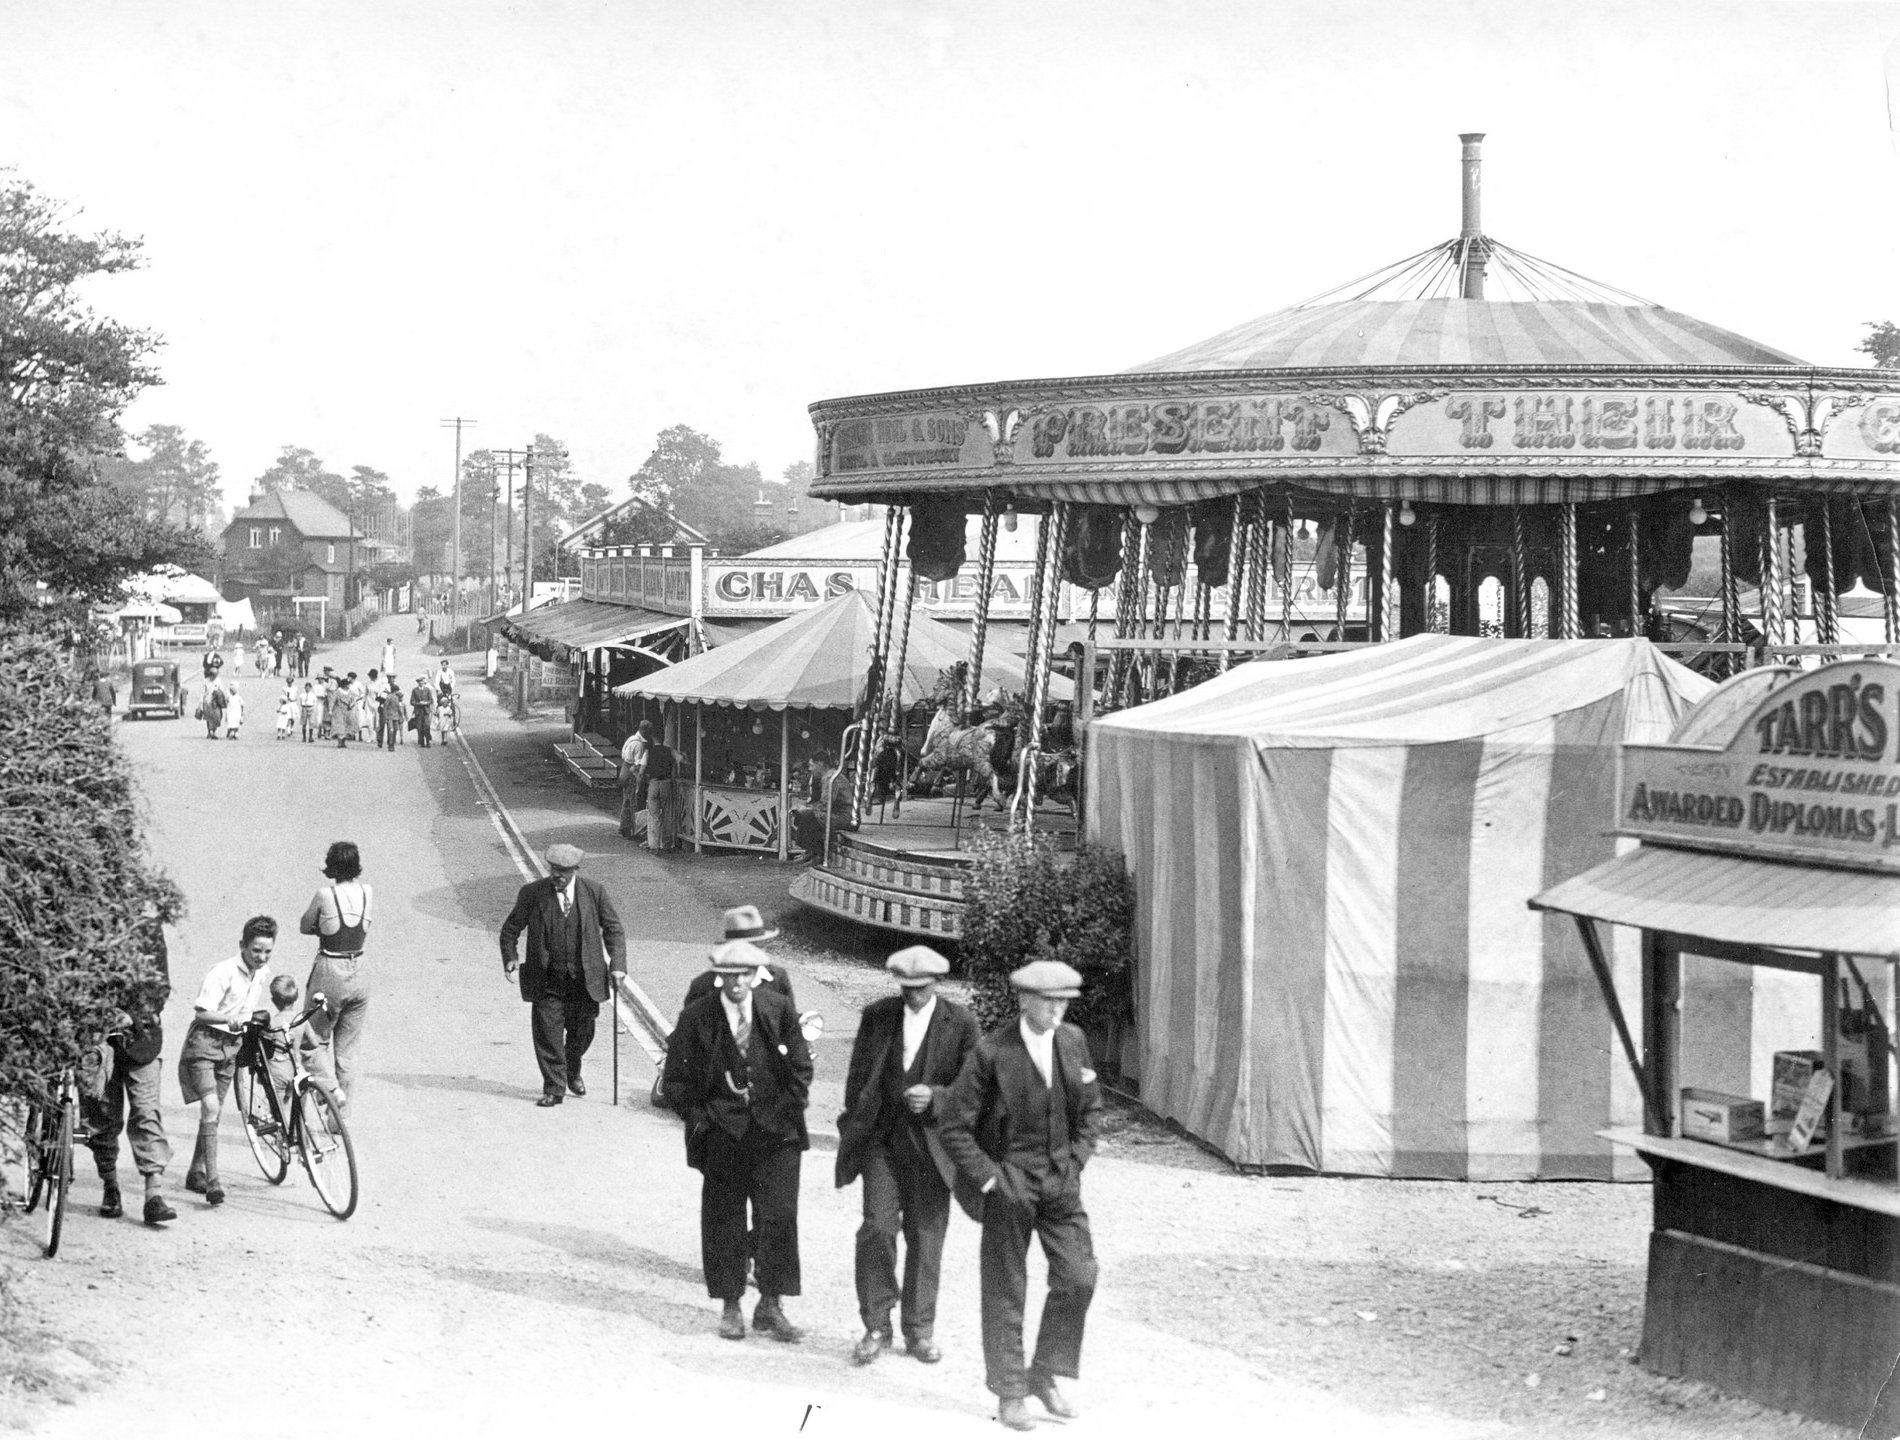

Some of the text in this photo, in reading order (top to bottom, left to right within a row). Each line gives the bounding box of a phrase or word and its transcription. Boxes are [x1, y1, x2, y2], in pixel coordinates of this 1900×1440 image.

[1032, 400, 1331, 458] PRESENT
[1445, 394, 1745, 451] THEIR
[715, 570, 855, 603] CHAS
[910, 573, 1047, 605] HEA
[1756, 673, 1887, 762] TARR'S
[1747, 763, 1900, 798] ESTABLISHED
[1627, 781, 1746, 829] AWARDED
[1750, 791, 1877, 843] DIPLOMAS
